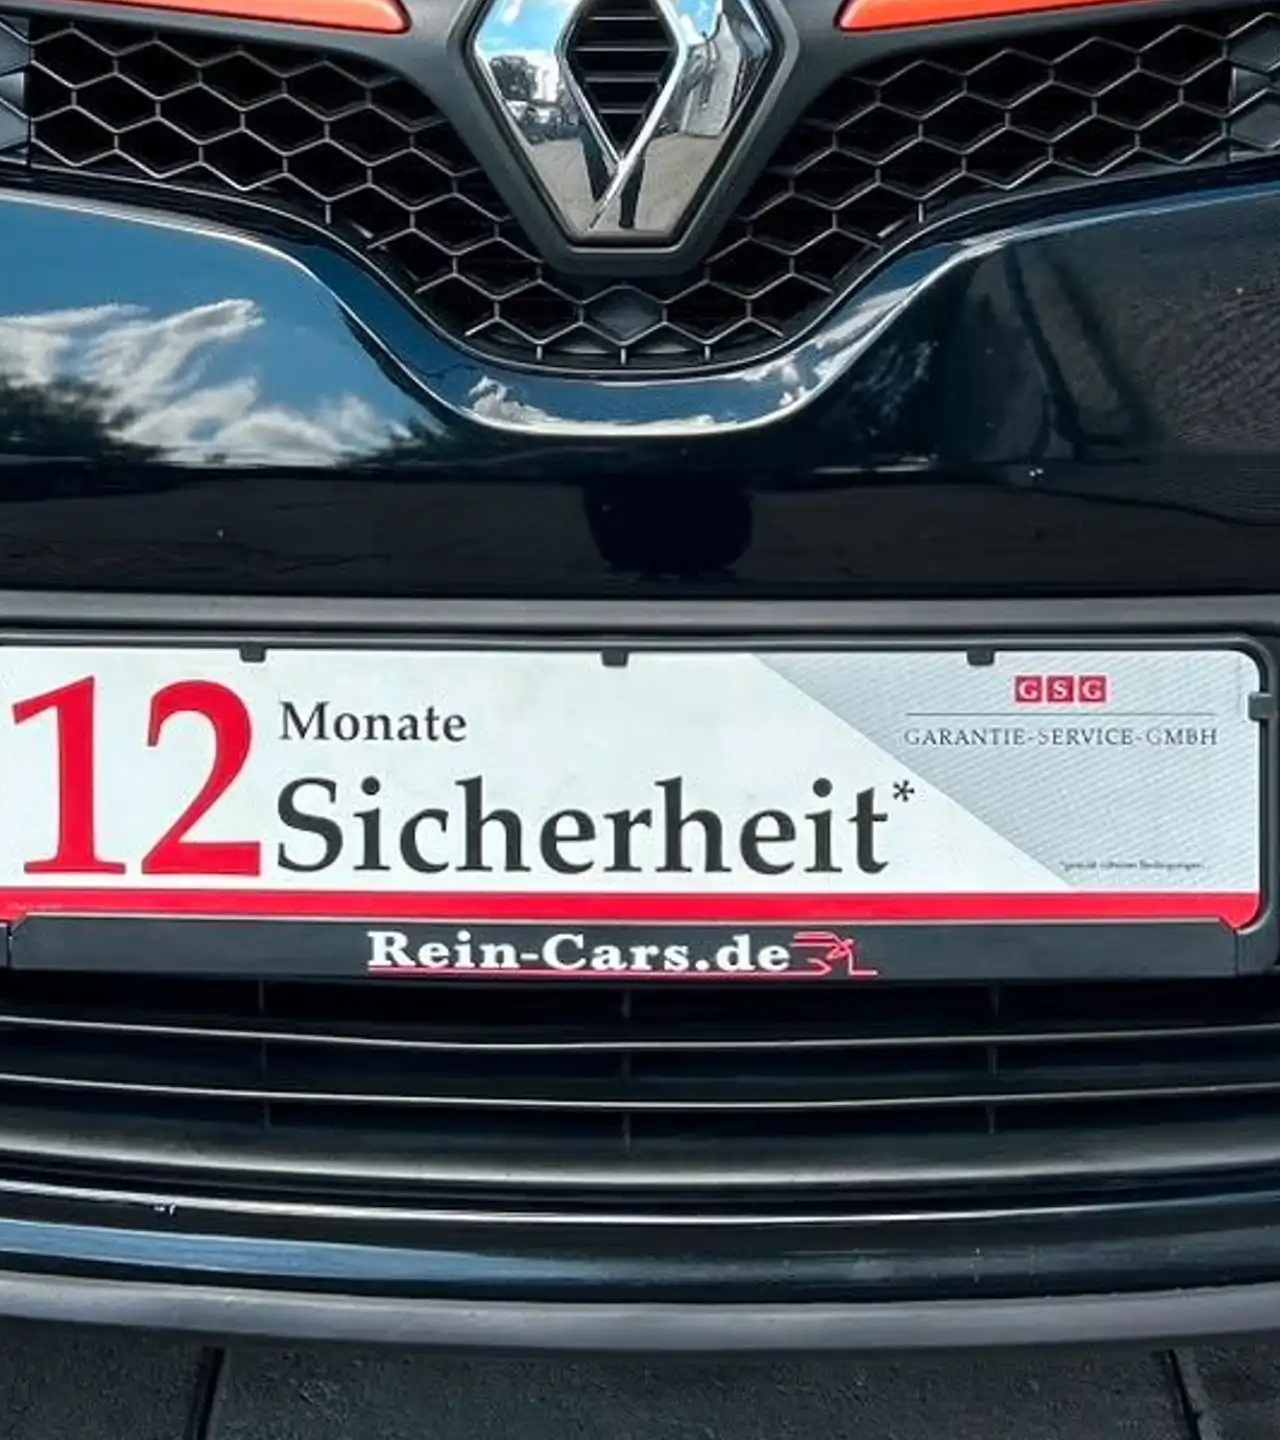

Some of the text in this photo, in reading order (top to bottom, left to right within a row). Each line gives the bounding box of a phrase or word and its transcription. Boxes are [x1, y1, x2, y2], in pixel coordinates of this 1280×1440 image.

[1017, 677, 1106, 702] GSG
[280, 700, 467, 743] Monate
[903, 727, 1218, 746] GARANTIE-SERVICE-GMBH
[12, 676, 262, 877] 12
[367, 930, 791, 971] Rein-Cars.de
